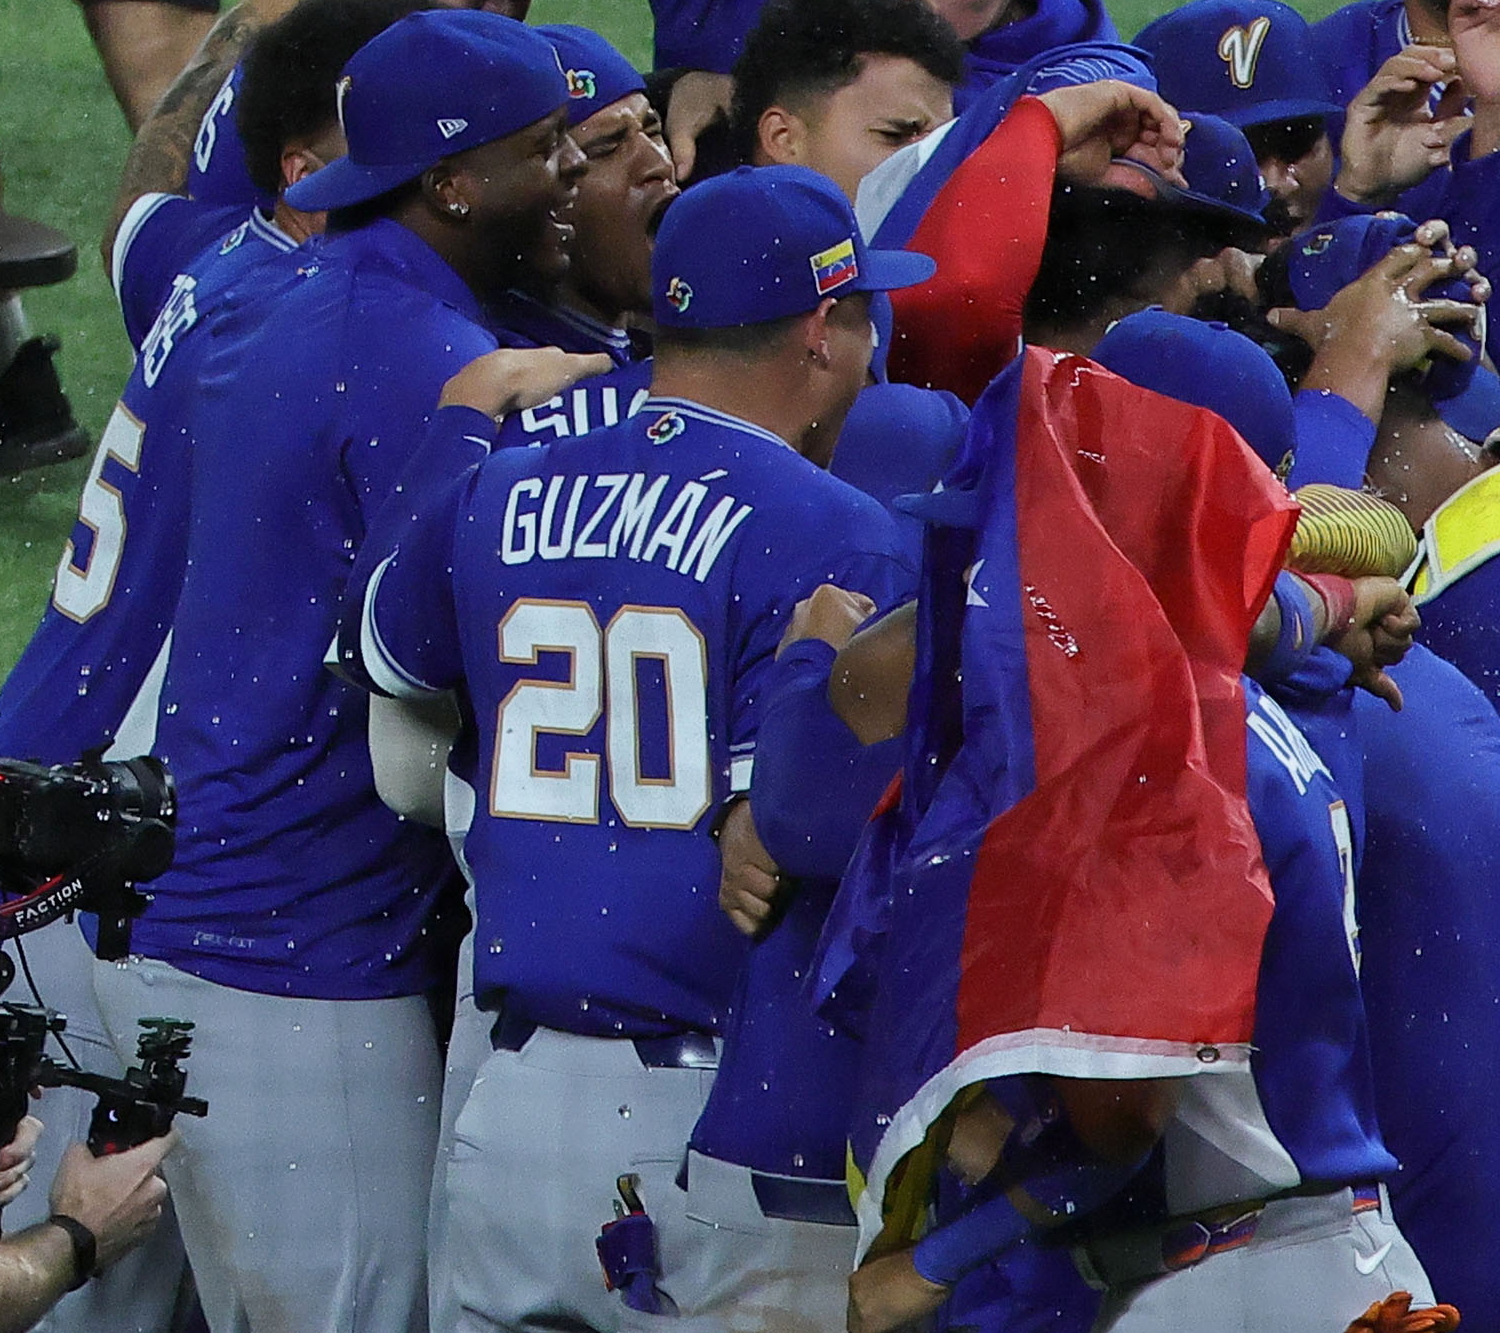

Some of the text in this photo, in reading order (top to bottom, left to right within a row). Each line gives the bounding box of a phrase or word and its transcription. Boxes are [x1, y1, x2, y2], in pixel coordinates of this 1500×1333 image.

[1217, 16, 1271, 89] V
[52, 401, 147, 624] 5
[499, 469, 753, 583] GUZMÁN
[489, 597, 713, 831] 20
[15, 878, 82, 924] FACTION
